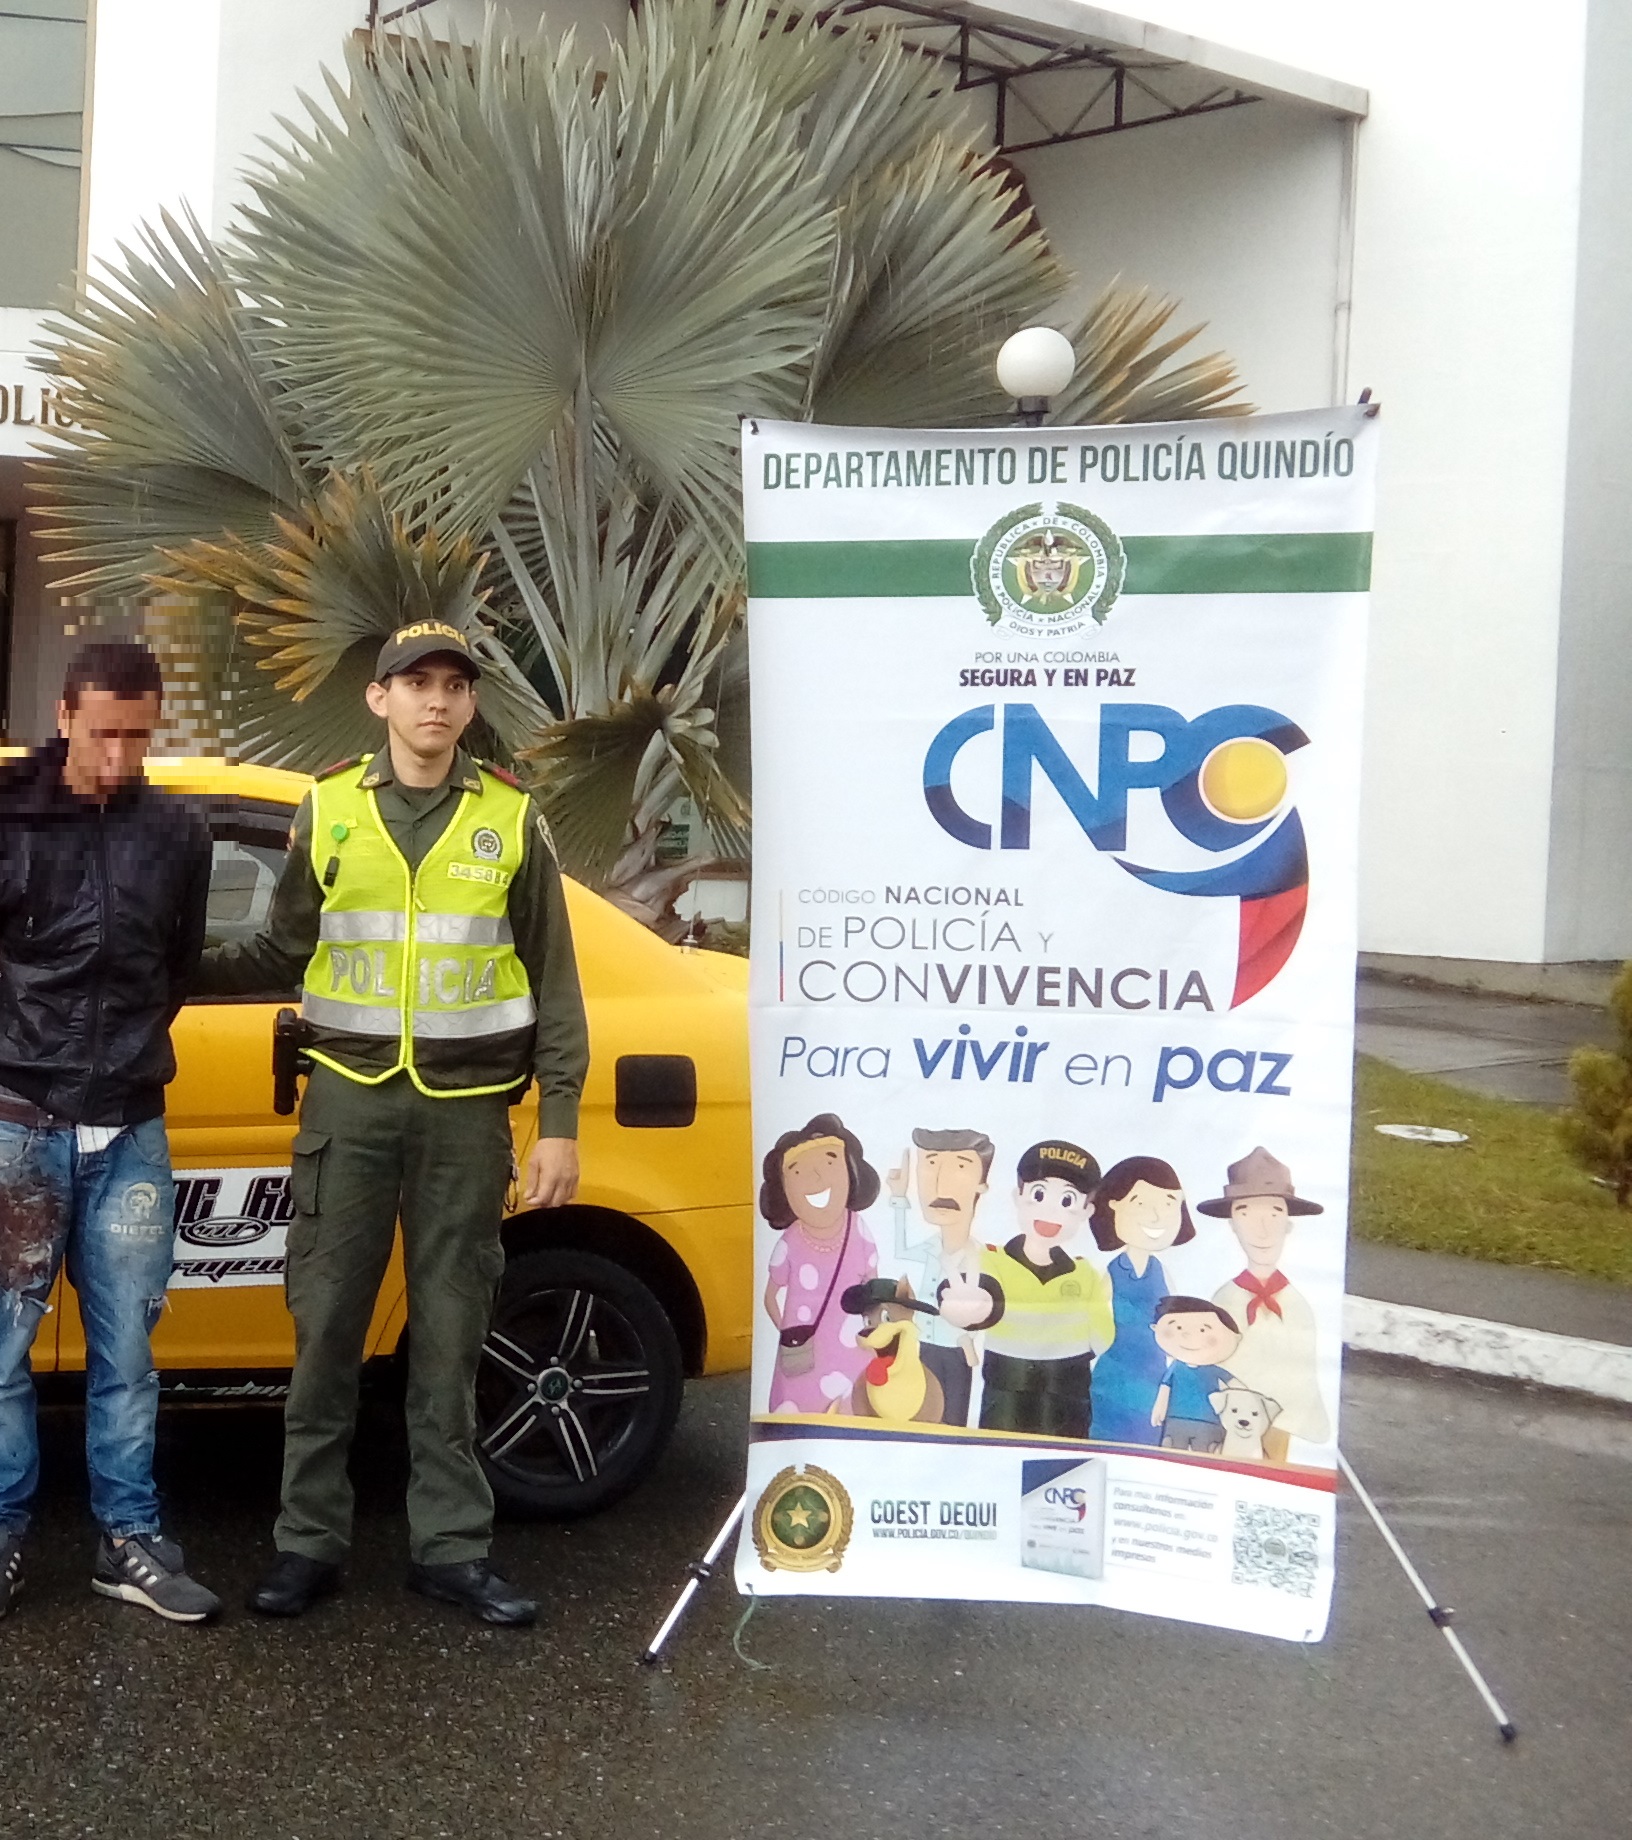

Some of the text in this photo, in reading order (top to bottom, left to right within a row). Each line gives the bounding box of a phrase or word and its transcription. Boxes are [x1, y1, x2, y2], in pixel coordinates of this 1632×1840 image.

[763, 431, 1354, 489] DEPARTAMENTO DE POLICÍA QUINDÍO
[1042, 517, 1059, 526] DE
[1071, 523, 1105, 578] COLOMBIA
[1047, 591, 1101, 623] NACIONAL
[1047, 622, 1086, 636] PATRIA
[975, 651, 1120, 664] POR UNA COLOMBIA
[959, 668, 1137, 687] SEGURA Y EN PAZ
[923, 703, 1311, 853] CNPC
[798, 885, 1024, 907] CÓDIGO NACIONAL
[798, 910, 1054, 953] DE POLICÍA Y
[329, 948, 495, 1006] POLICIA
[798, 960, 1215, 1012] CONVIVENCIA
[780, 1023, 1294, 1103] Para vivir en paz
[1039, 1147, 1087, 1169] POLICIA
[870, 1499, 997, 1527] COEST DEQUI
